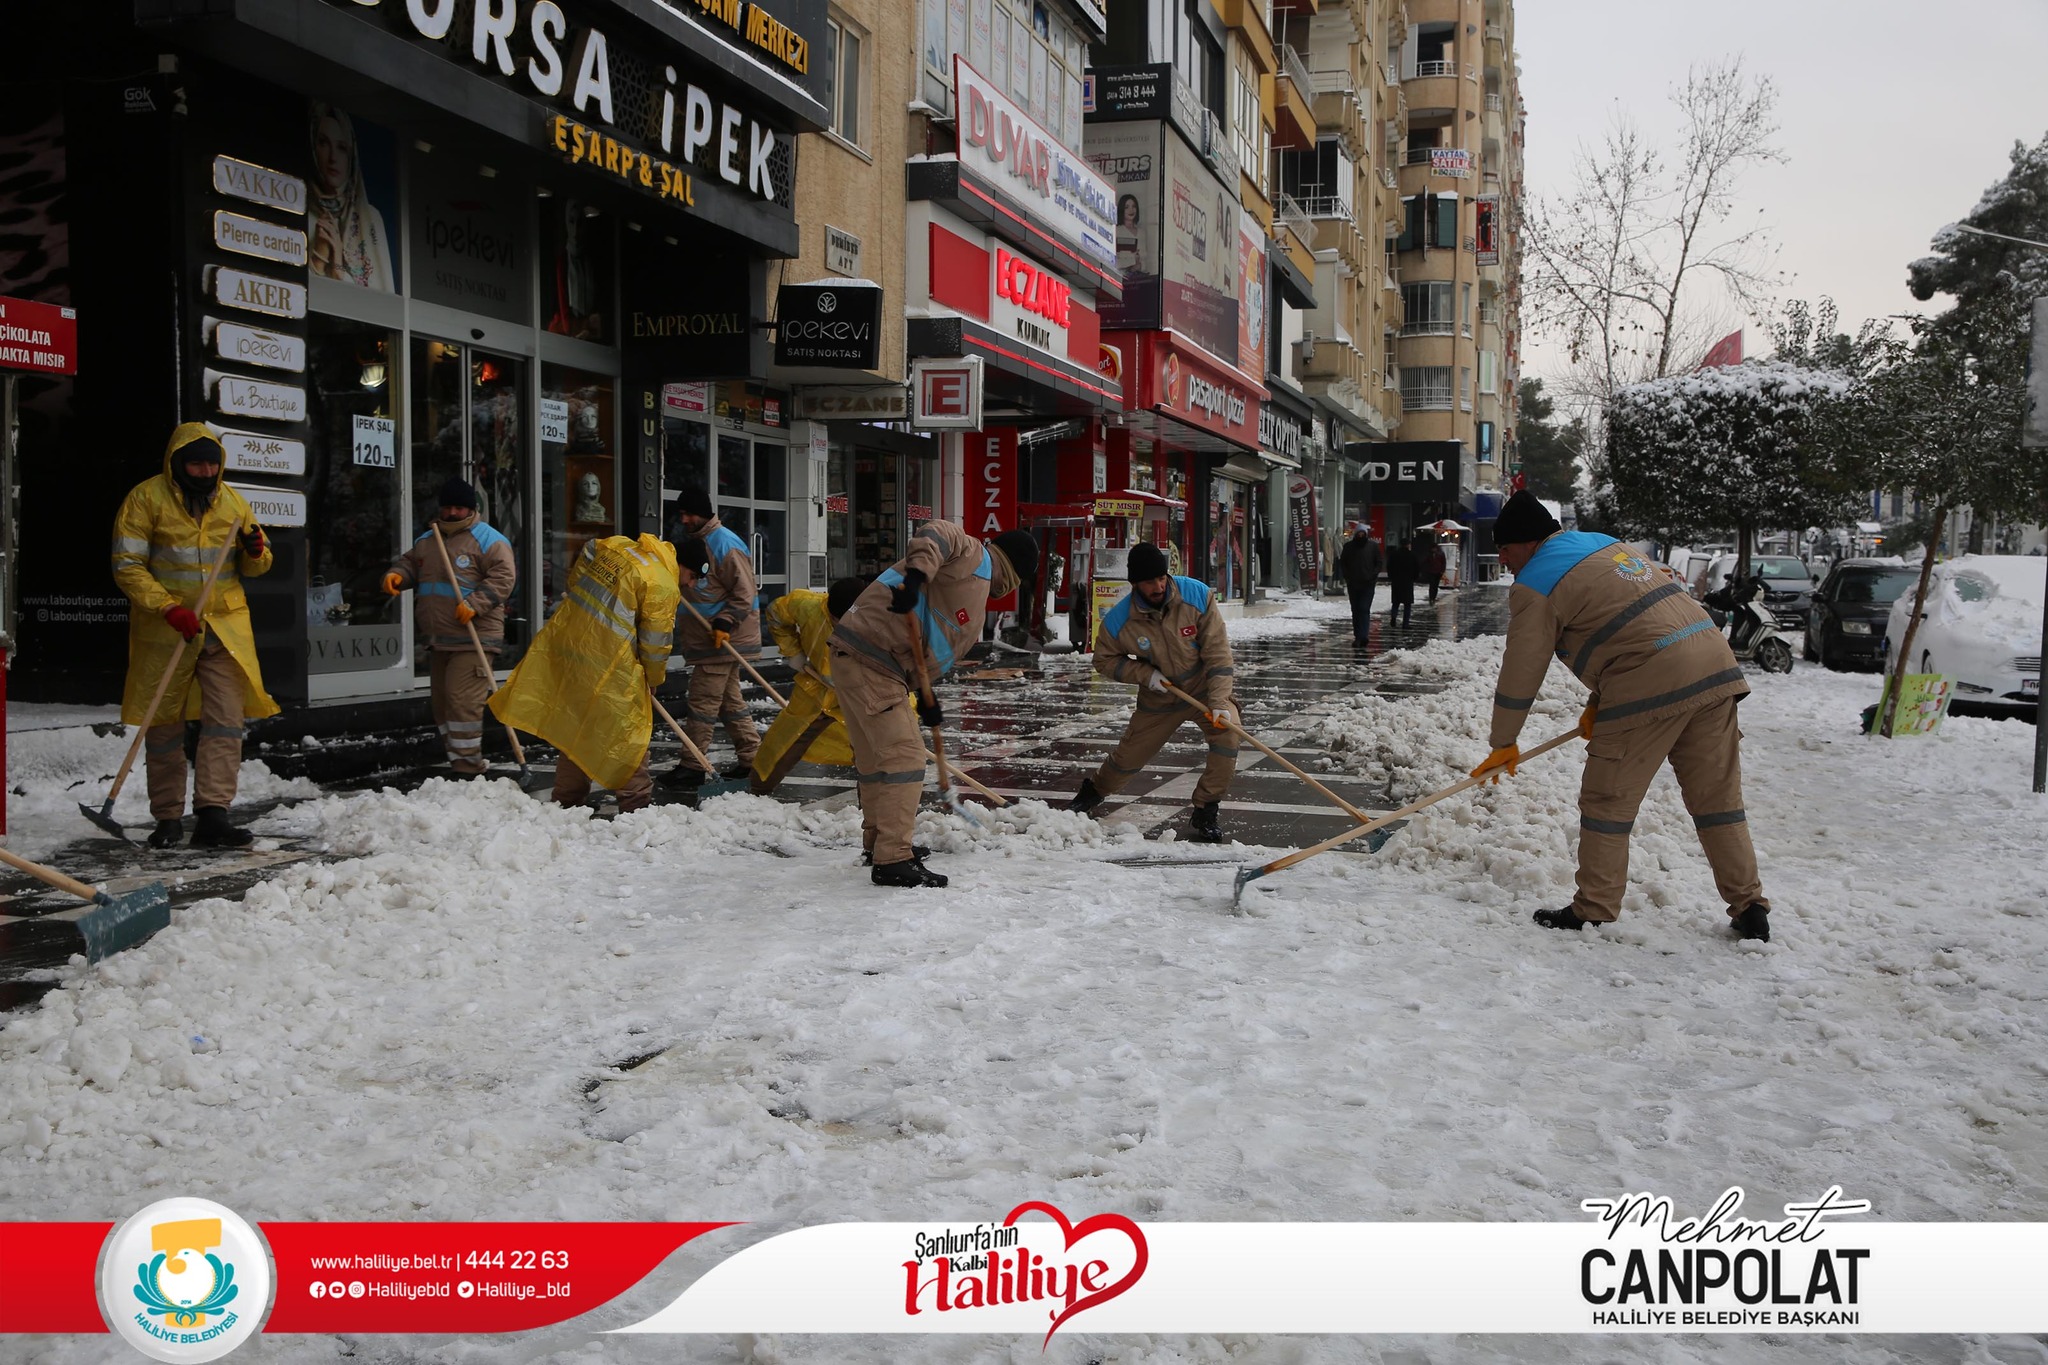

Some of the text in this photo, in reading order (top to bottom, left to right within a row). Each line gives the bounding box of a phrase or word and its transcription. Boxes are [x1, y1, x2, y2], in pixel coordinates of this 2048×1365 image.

[124, 86, 156, 107] Gök
[1119, 86, 1132, 99] 314
[1141, 84, 1156, 97] 444
[661, 65, 775, 200] İPEK
[967, 83, 1050, 199] DUYAR
[555, 117, 695, 207] EŞARP & ŞAL
[1103, 154, 1152, 176] BURS
[1432, 158, 1470, 169] SATILIK
[223, 165, 298, 205] VAKKO
[222, 221, 301, 257] Pierre cardin
[425, 205, 514, 270] ipekevi
[435, 270, 463, 295] SATIŞ
[997, 248, 1071, 329] ECZANE
[233, 281, 292, 312] AKER
[633, 311, 744, 338] EMPROYAL
[781, 320, 870, 343] ipekevi
[1017, 317, 1050, 351] KUMUK
[33, 350, 65, 369] MISIR
[236, 337, 292, 362] ipekevi
[787, 347, 862, 359] SATIŞ NOKTASI
[249, 385, 298, 413] Boutique
[804, 396, 904, 413] ECZANE
[932, 377, 961, 414] E
[1187, 374, 1246, 428] pasaport pizza
[356, 416, 392, 434] İPEK ŞAL
[542, 424, 558, 438] 120
[1275, 417, 1298, 457] OPTİK
[355, 442, 395, 467] 120 TL
[643, 391, 657, 518] BURSA
[982, 437, 1002, 545] ECZA
[249, 501, 297, 517] PROYAL
[1097, 501, 1142, 510] SÜT MISIR
[1095, 585, 1111, 593] SÜT
[317, 637, 398, 658] VAKKO
